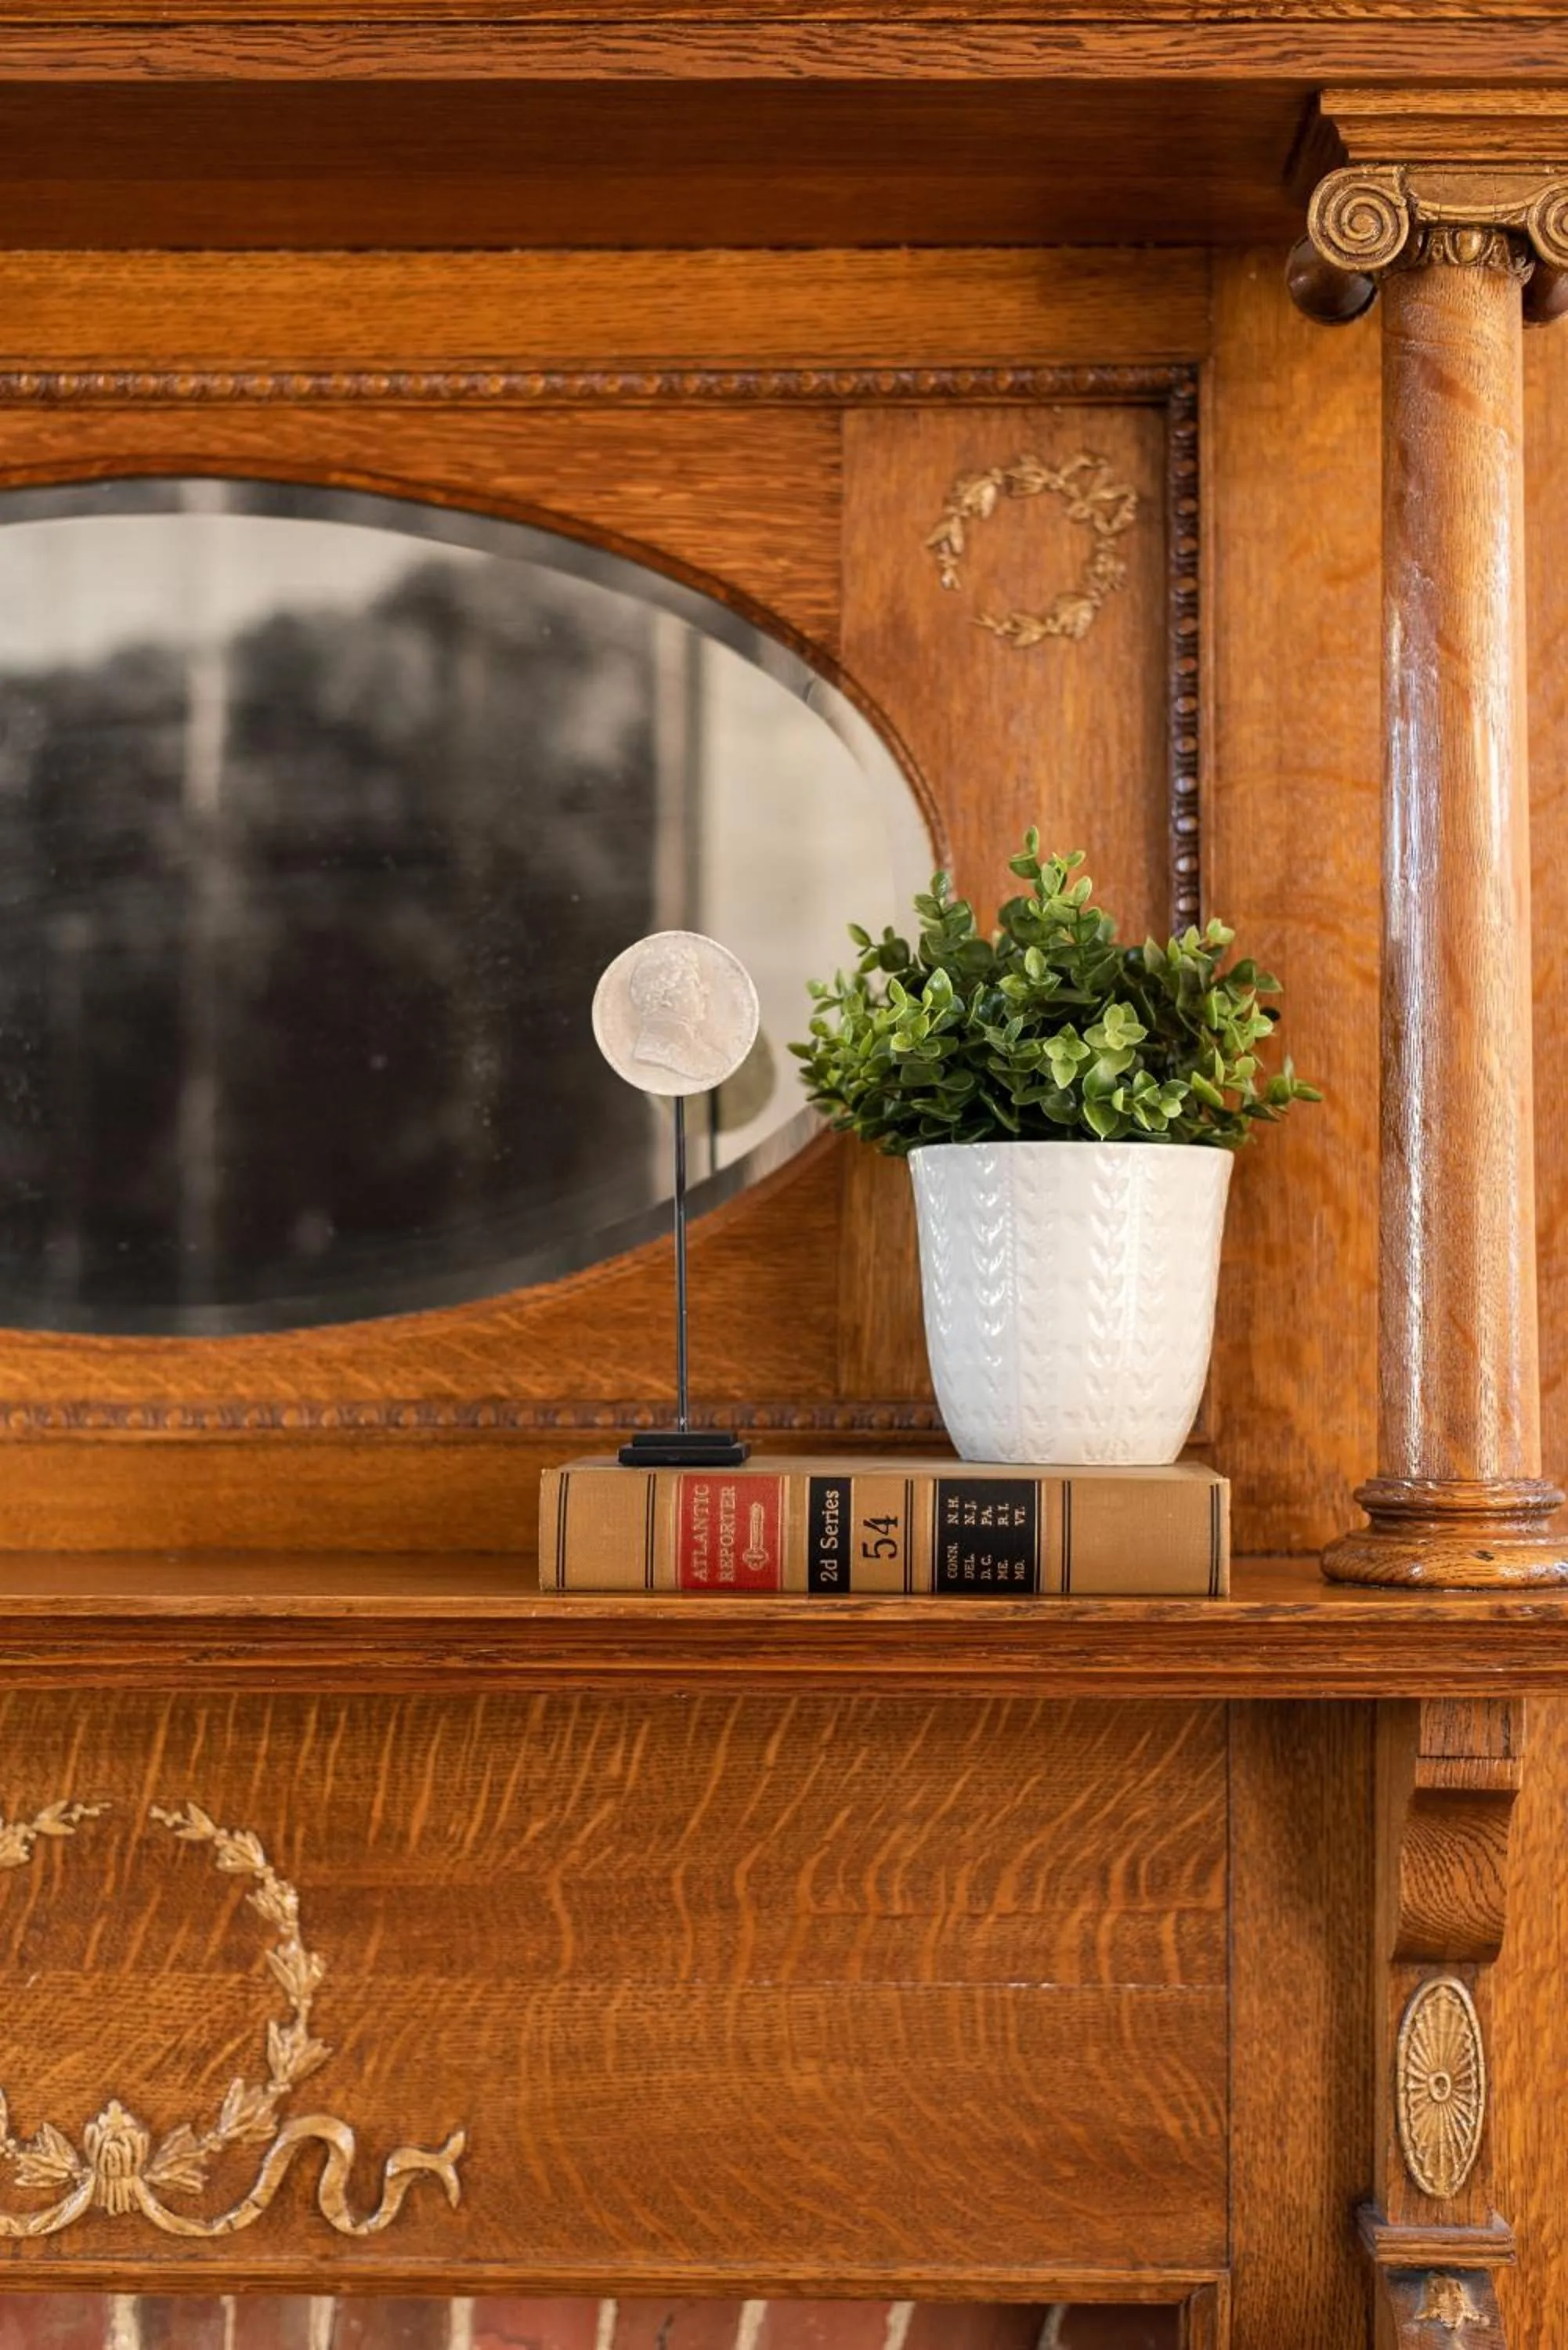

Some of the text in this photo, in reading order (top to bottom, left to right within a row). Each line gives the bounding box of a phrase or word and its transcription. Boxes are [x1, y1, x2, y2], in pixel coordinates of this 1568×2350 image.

[693, 1484, 709, 1582] ATLANTIC
[719, 1486, 735, 1582] REPORTER
[981, 1506, 993, 1526] PA.
[1014, 1506, 1025, 1526] VT.
[820, 1490, 840, 1582] 2d Series
[862, 1513, 898, 1560] 54
[947, 1542, 959, 1579] CONN.
[964, 1553, 975, 1580] DEL.
[1014, 1560, 1025, 1580] MD.
